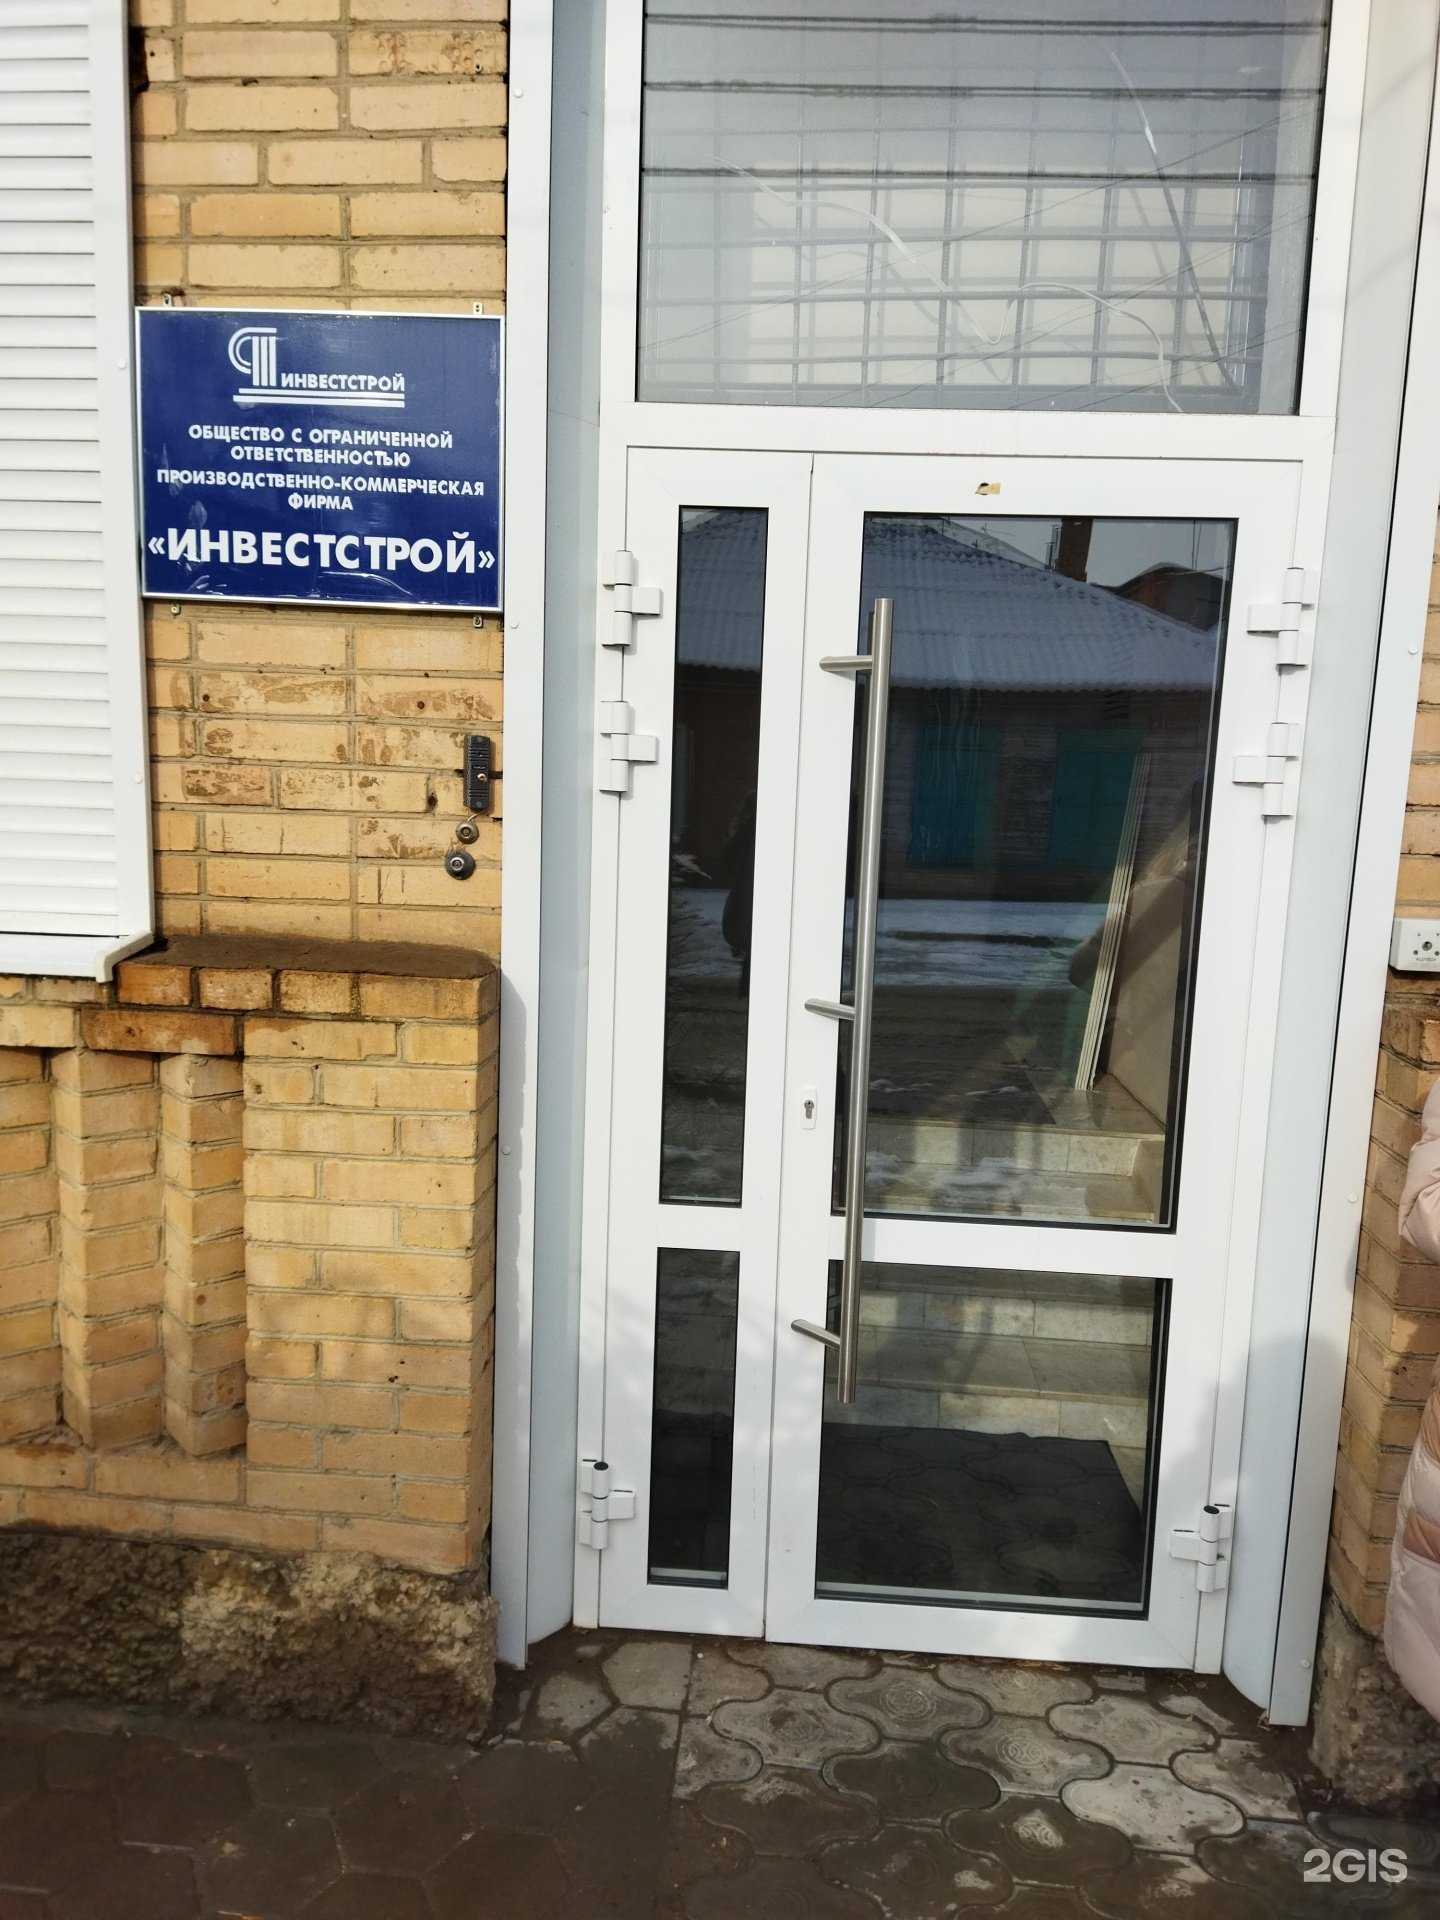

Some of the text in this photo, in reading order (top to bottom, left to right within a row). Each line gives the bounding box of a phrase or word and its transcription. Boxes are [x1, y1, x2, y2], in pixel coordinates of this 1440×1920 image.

[281, 372, 405, 391] ИНВЕСТСТРОЙ
[188, 425, 453, 448] ОБЩЕСТВО С ОГРАНИЧЕННОЙ
[230, 447, 411, 467] ОТВЕТСТВЕННОСТЬЮ
[156, 469, 485, 496] ПРОИЗВОДСТВЕННО-КОММЕРЧЕСКАЯ
[288, 492, 354, 511] ФИРМА
[148, 527, 495, 574] «ИНВЕСТСТРОЙ»
